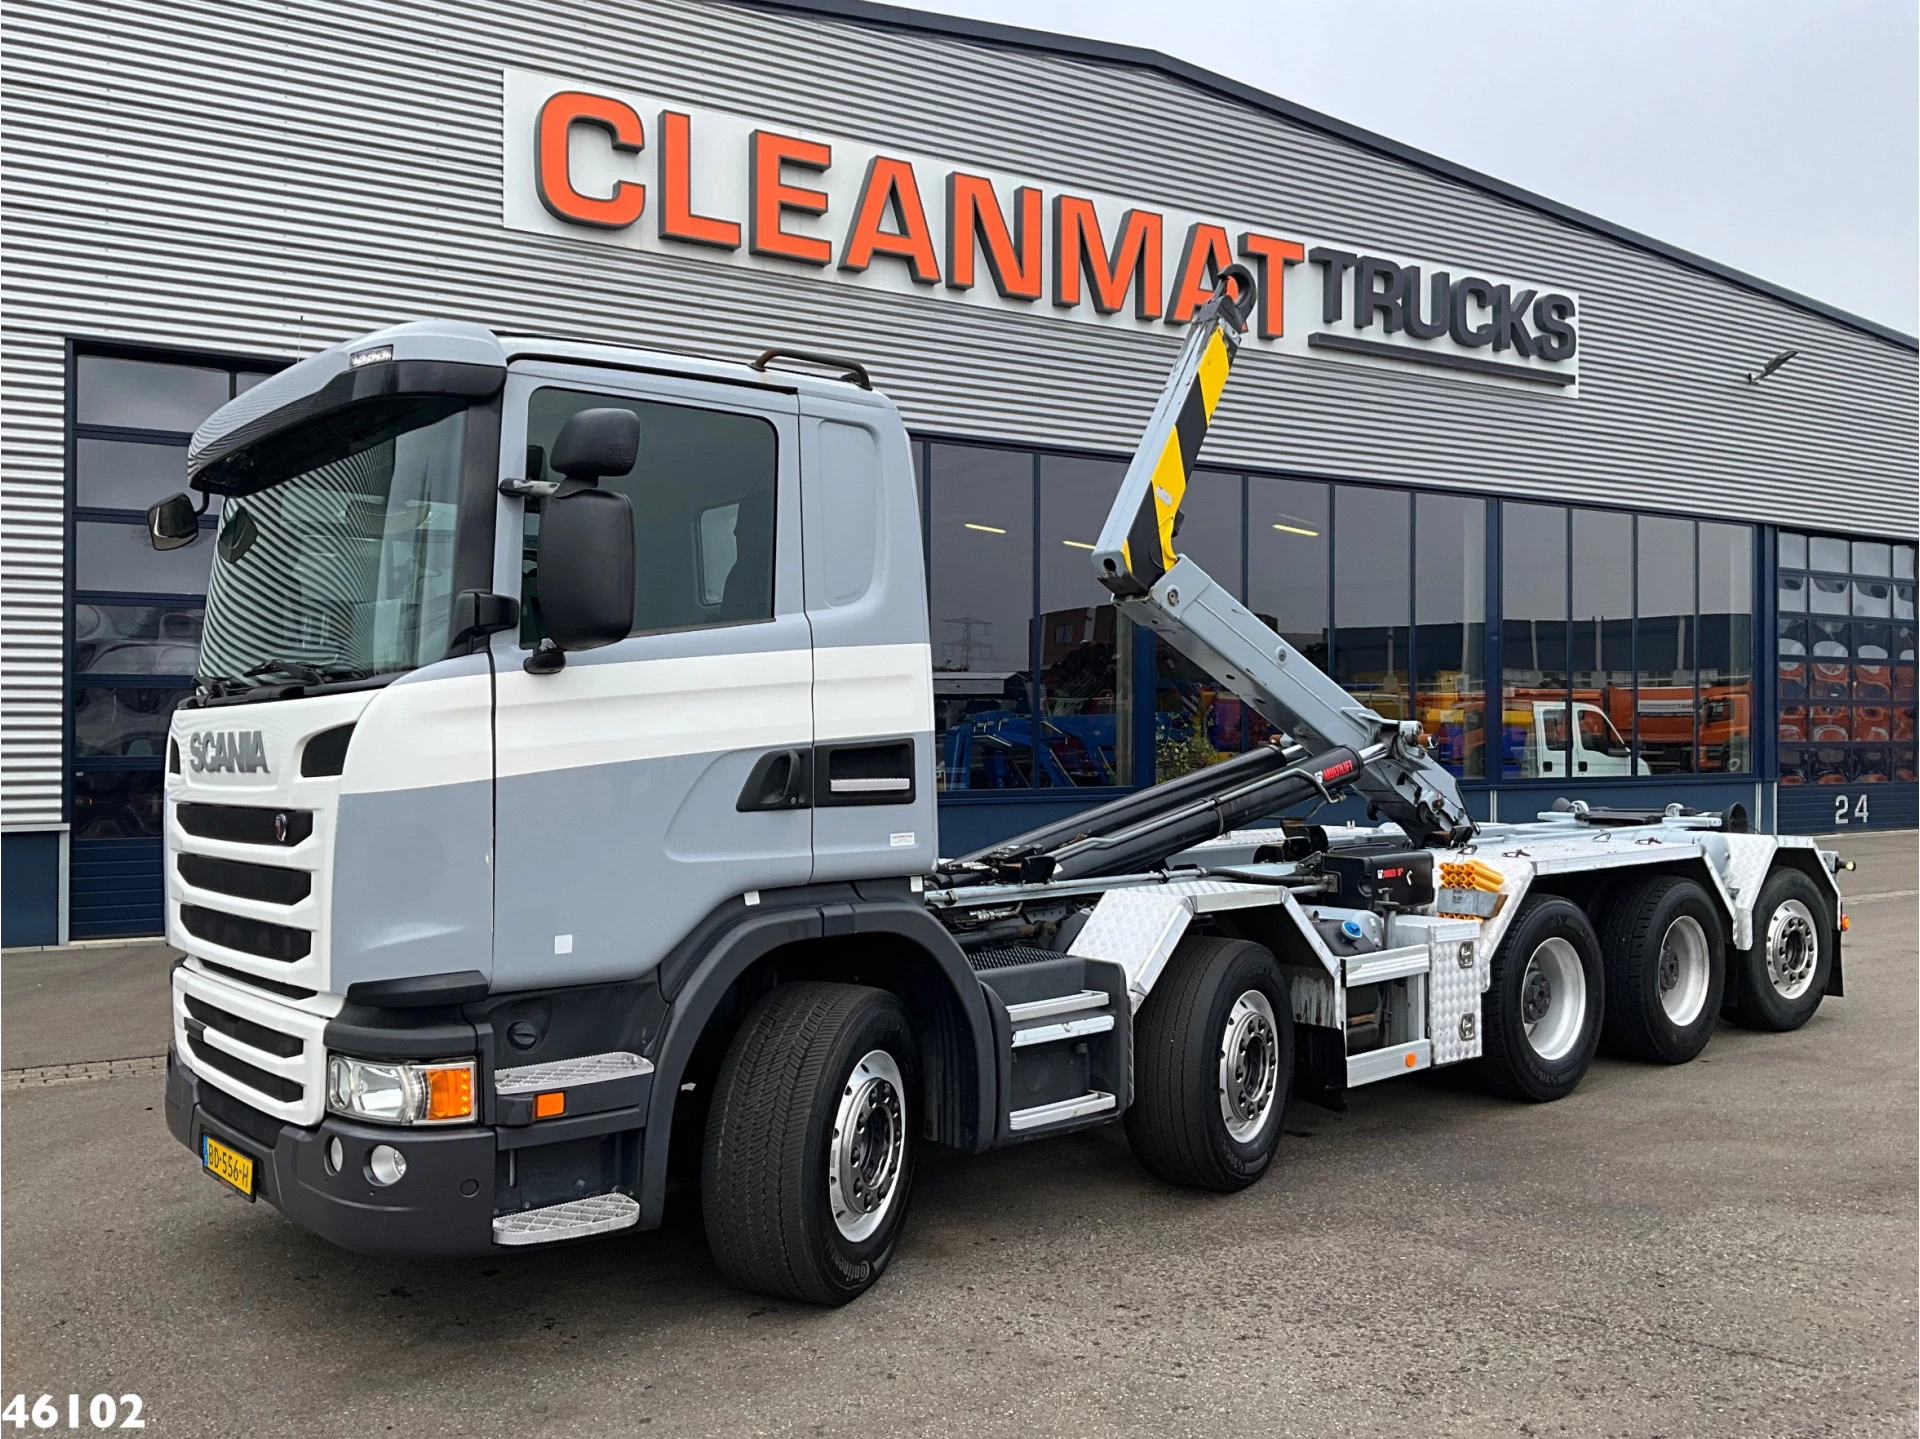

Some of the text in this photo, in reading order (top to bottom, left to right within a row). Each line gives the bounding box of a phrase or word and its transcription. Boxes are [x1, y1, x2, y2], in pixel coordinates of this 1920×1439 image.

[535, 90, 1577, 361] CLEANMAT TRUCKS
[190, 730, 271, 774] SCANIA
[1835, 795, 1869, 825] 24
[208, 1143, 249, 1188] BD-556-H
